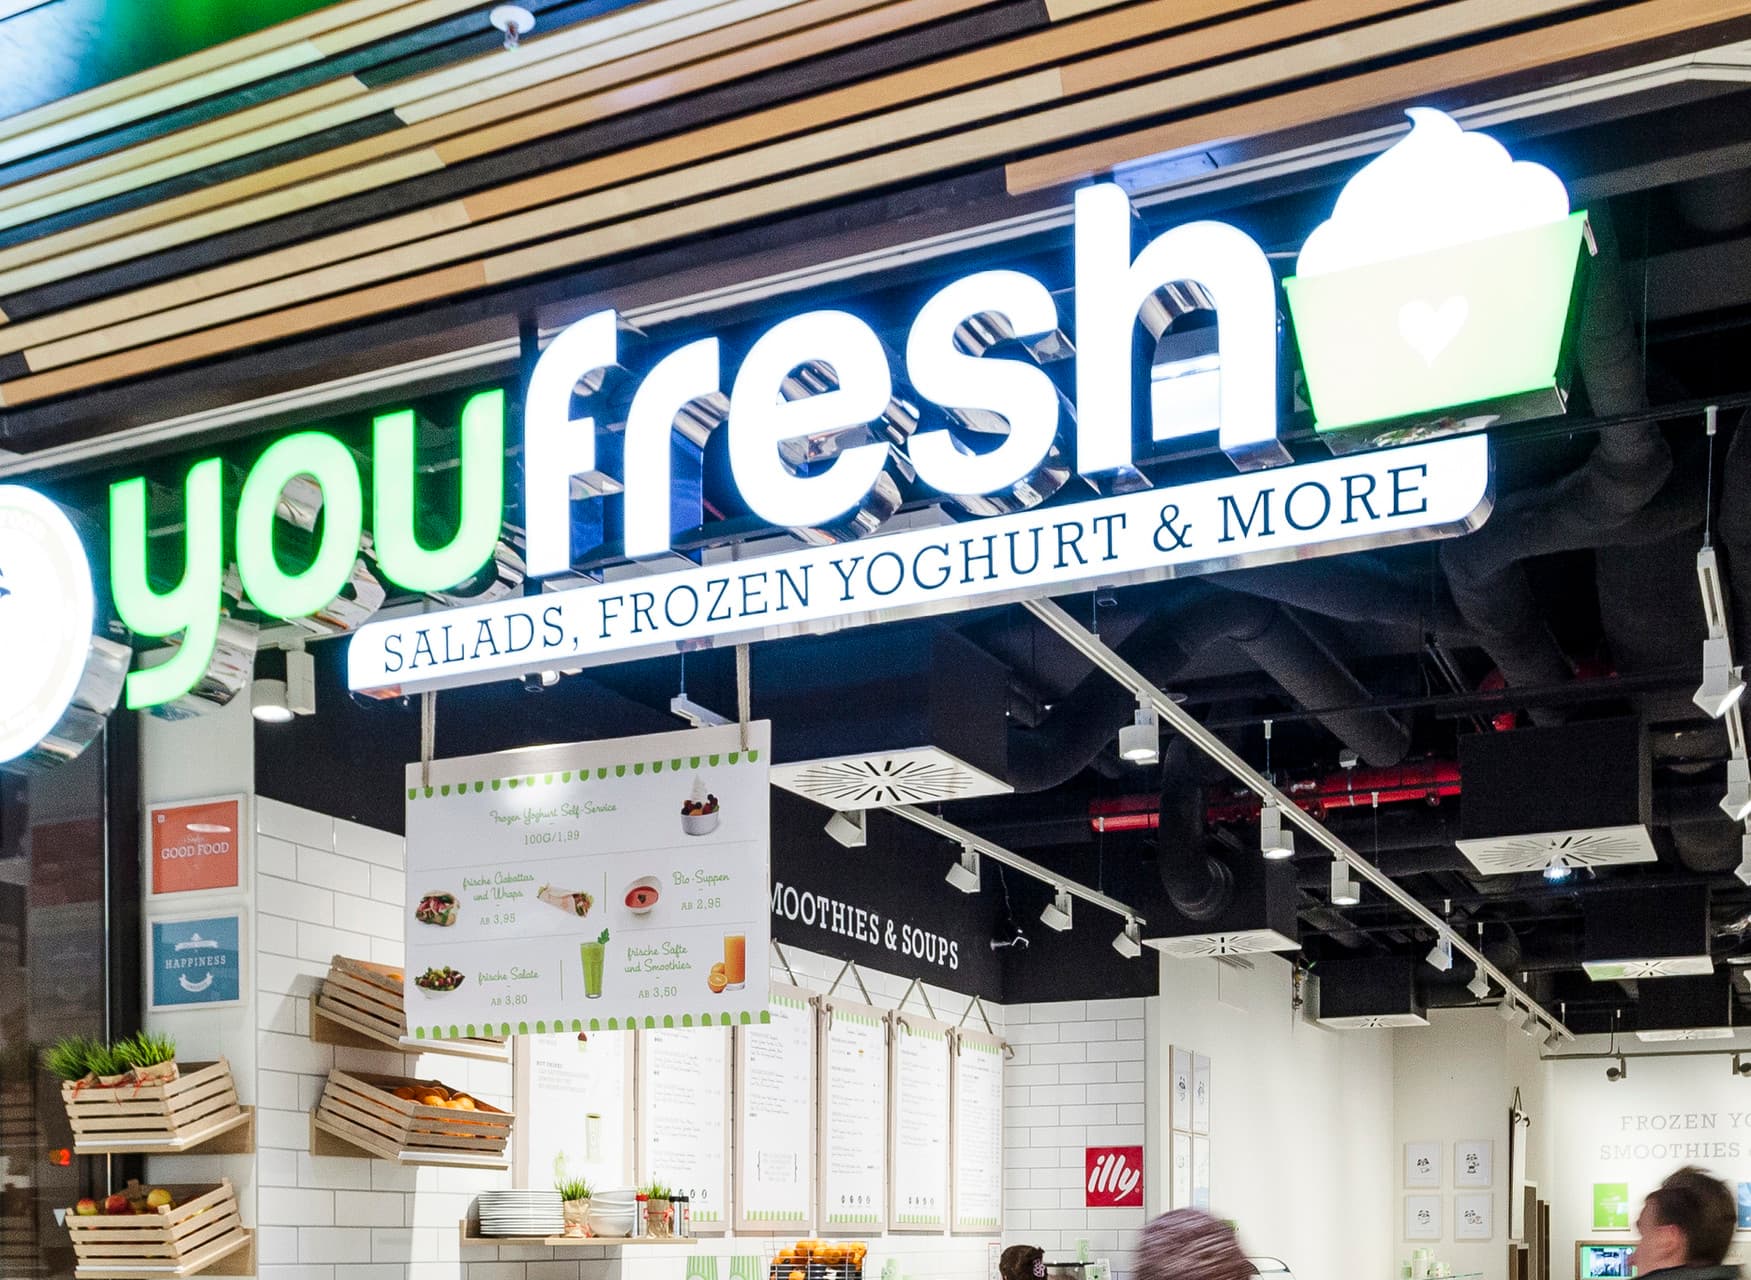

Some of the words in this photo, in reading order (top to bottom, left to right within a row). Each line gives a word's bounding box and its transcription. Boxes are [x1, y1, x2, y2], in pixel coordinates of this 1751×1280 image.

[383, 605, 579, 674] SALADS,
[599, 564, 813, 638] FROZEN
[829, 514, 1127, 600] YOGHURT
[1152, 504, 1193, 552] &
[1217, 464, 1428, 544] MORE
[489, 810, 520, 825] Frozen
[523, 808, 558, 825] Yoghurt
[161, 845, 195, 860] GOOD
[197, 842, 229, 856] FOOD
[463, 874, 491, 890] frische
[473, 890, 488, 901] und
[491, 887, 524, 902] Wraps
[627, 945, 658, 961] frische
[885, 919, 897, 950] &
[902, 924, 958, 970] SOUPS
[165, 954, 226, 969] HAPPINESS
[625, 962, 641, 973] und
[644, 959, 691, 972] Smoothies
[478, 970, 508, 985] frische
[1621, 1113, 1717, 1131] FROZEN
[1600, 1142, 1740, 1160] SMOOTHIES
[1087, 1154, 1141, 1202] illy
